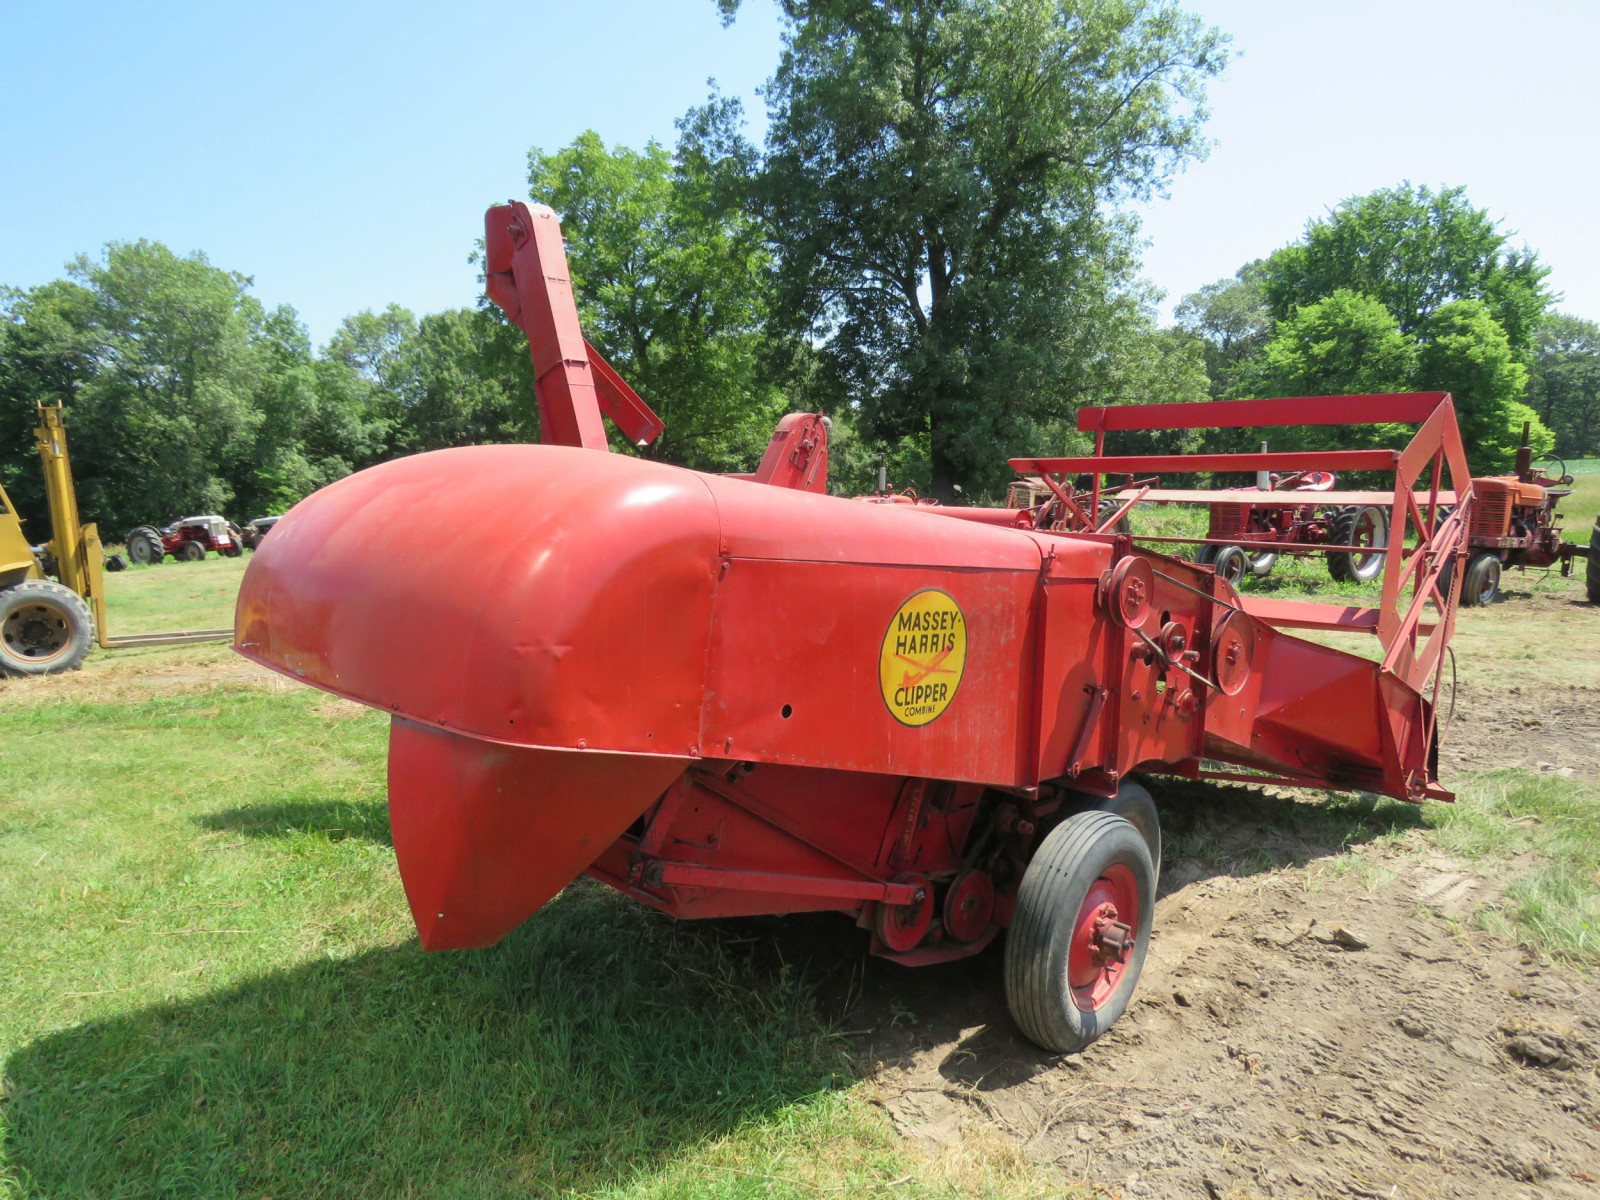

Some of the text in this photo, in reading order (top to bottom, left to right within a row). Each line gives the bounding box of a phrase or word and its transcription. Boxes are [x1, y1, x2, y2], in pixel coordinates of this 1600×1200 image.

[896, 633, 955, 655] HARRIS
[895, 683, 947, 706] CLIPPER
[904, 705, 936, 717] COMBINE
